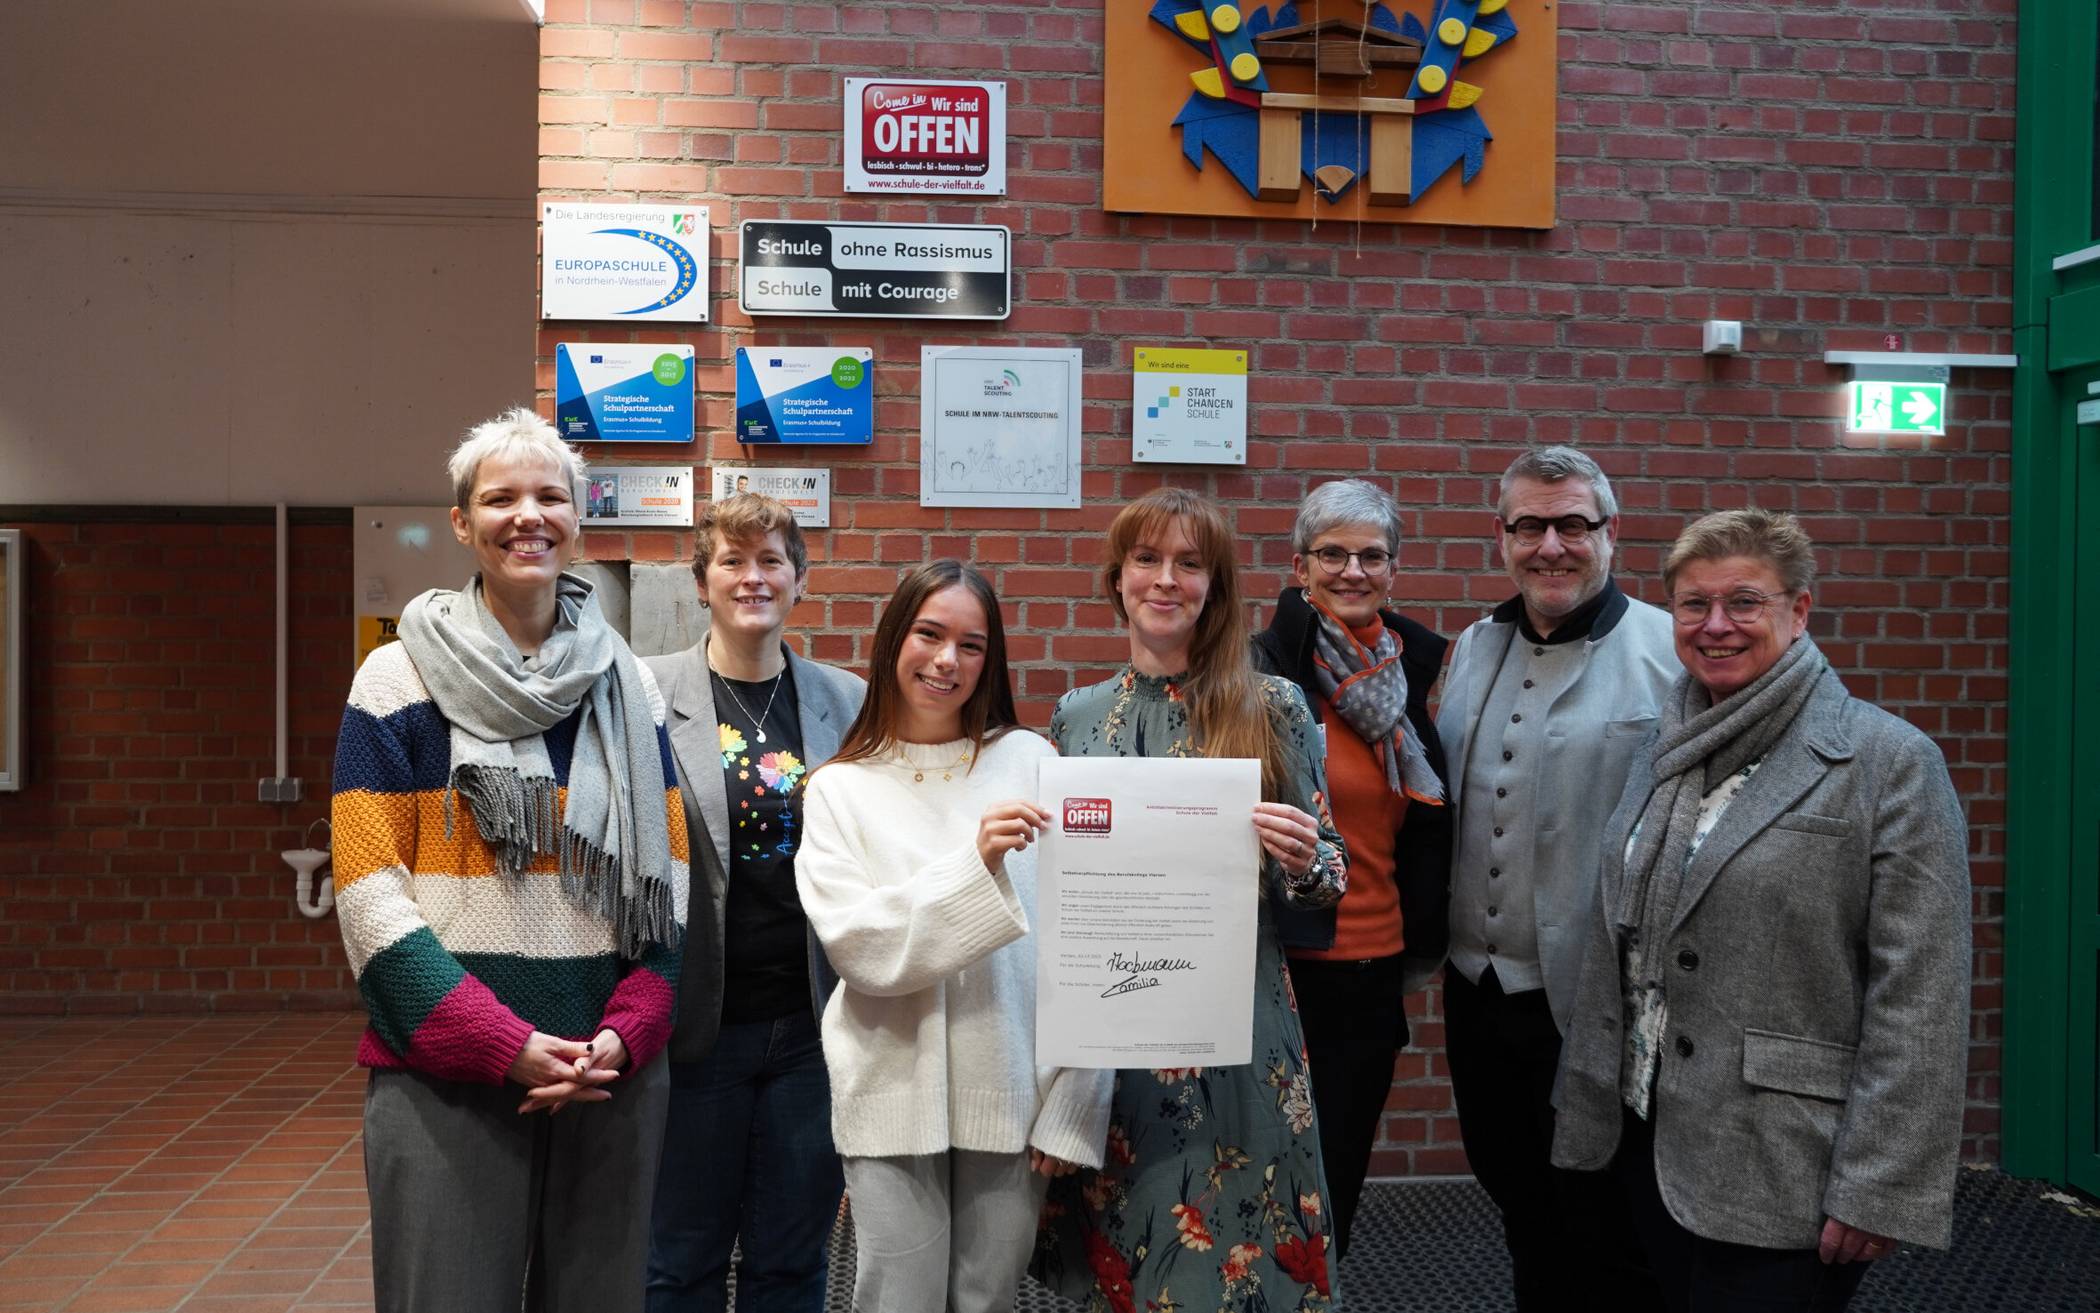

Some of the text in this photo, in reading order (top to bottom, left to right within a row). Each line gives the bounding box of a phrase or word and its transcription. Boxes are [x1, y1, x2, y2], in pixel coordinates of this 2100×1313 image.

[873, 90, 979, 112] Come in Wir sind
[873, 114, 979, 154] OFFEN
[867, 161, 895, 170] lesbisch
[899, 161, 923, 170] schwul
[926, 162, 934, 170] bi
[938, 162, 960, 171] hetero
[868, 179, 985, 190] www.schule-der-vielfalt.de
[555, 209, 665, 223] Die Landesregierung
[757, 239, 993, 259] Schule ohne Rassismus
[555, 259, 667, 272] EUROPASCHULE
[555, 276, 667, 287] in Nordrhein-Westfalen
[758, 280, 959, 303] Schule mit Courage
[1161, 361, 1175, 369] sind
[1187, 387, 1216, 398] START
[603, 395, 649, 404] Strategische
[783, 398, 828, 407] Strategische
[1187, 398, 1233, 409] CHANCEN
[603, 404, 674, 413] Schulpartnerschaft
[783, 408, 853, 416] Schulpartnerschaft
[1187, 409, 1221, 419] SCHULE
[945, 410, 970, 418] SCHULE
[982, 411, 1059, 419] NRW-TALENTSCOUTING
[620, 475, 662, 488] CHECK
[758, 477, 800, 489] CHECK
[1067, 810, 1108, 826] OFFEN
